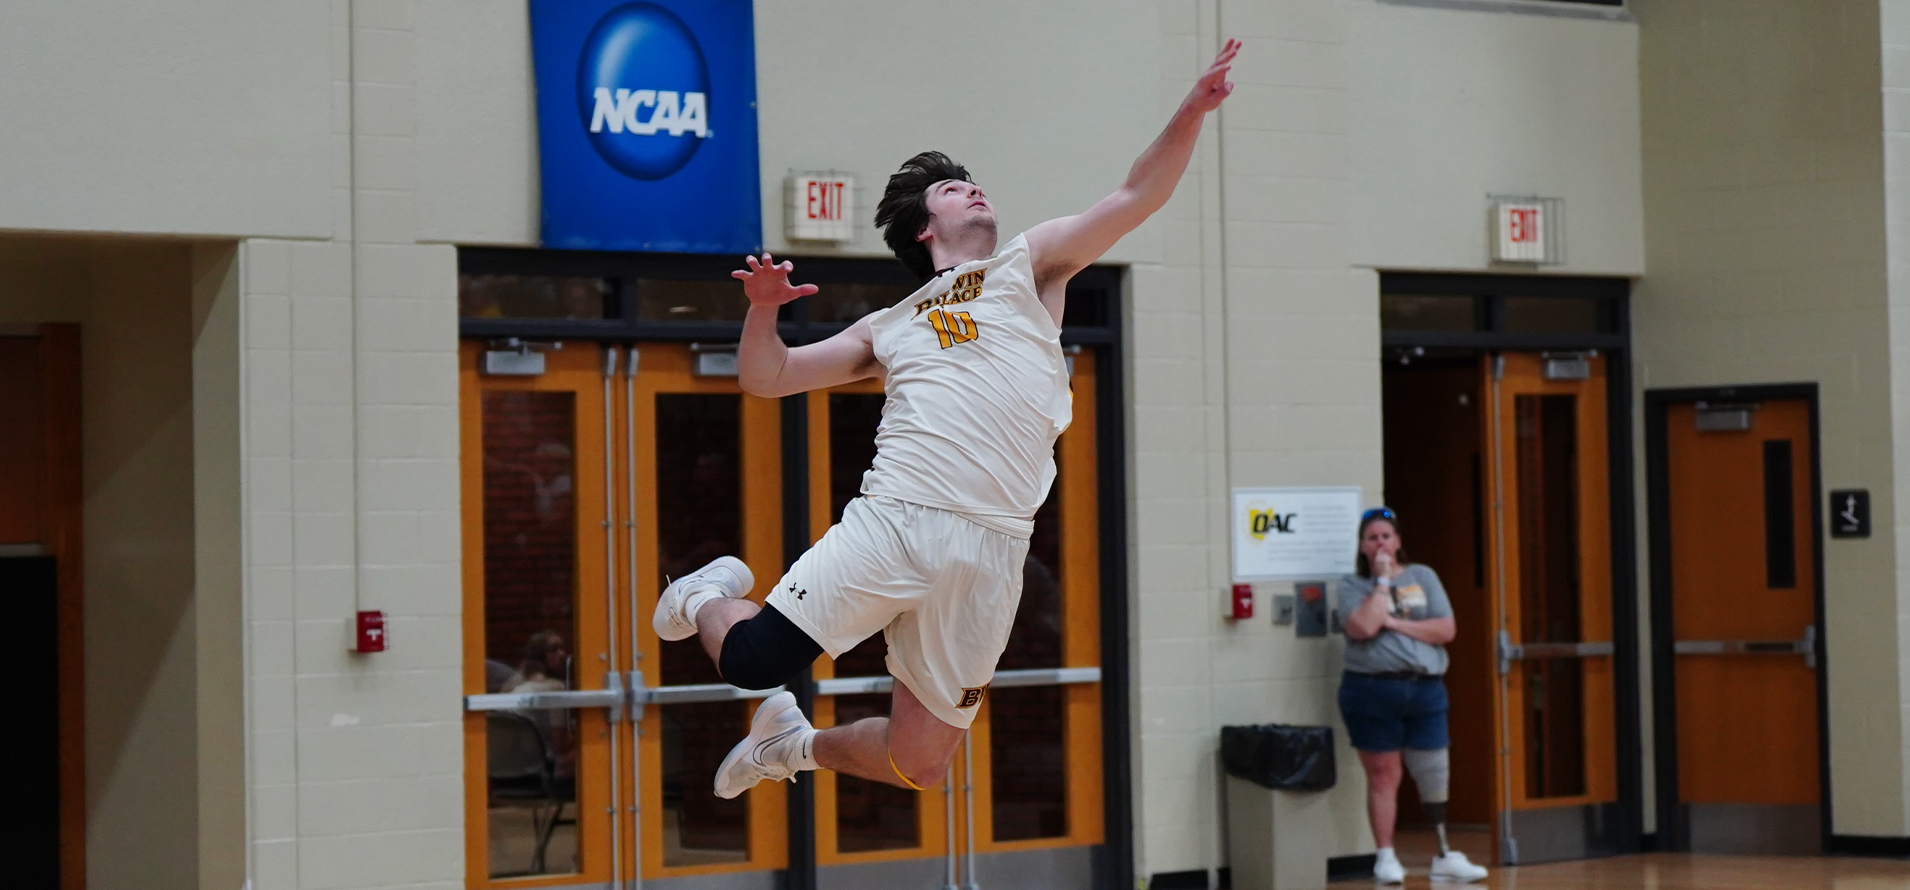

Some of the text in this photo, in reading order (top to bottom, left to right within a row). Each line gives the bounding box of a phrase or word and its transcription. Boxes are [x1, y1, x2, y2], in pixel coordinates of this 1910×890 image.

[590, 87, 708, 138] NCAA
[808, 182, 845, 220] EXIT
[1509, 208, 1538, 242] EXIT
[928, 309, 979, 349] 10
[1253, 512, 1297, 534] OAC
